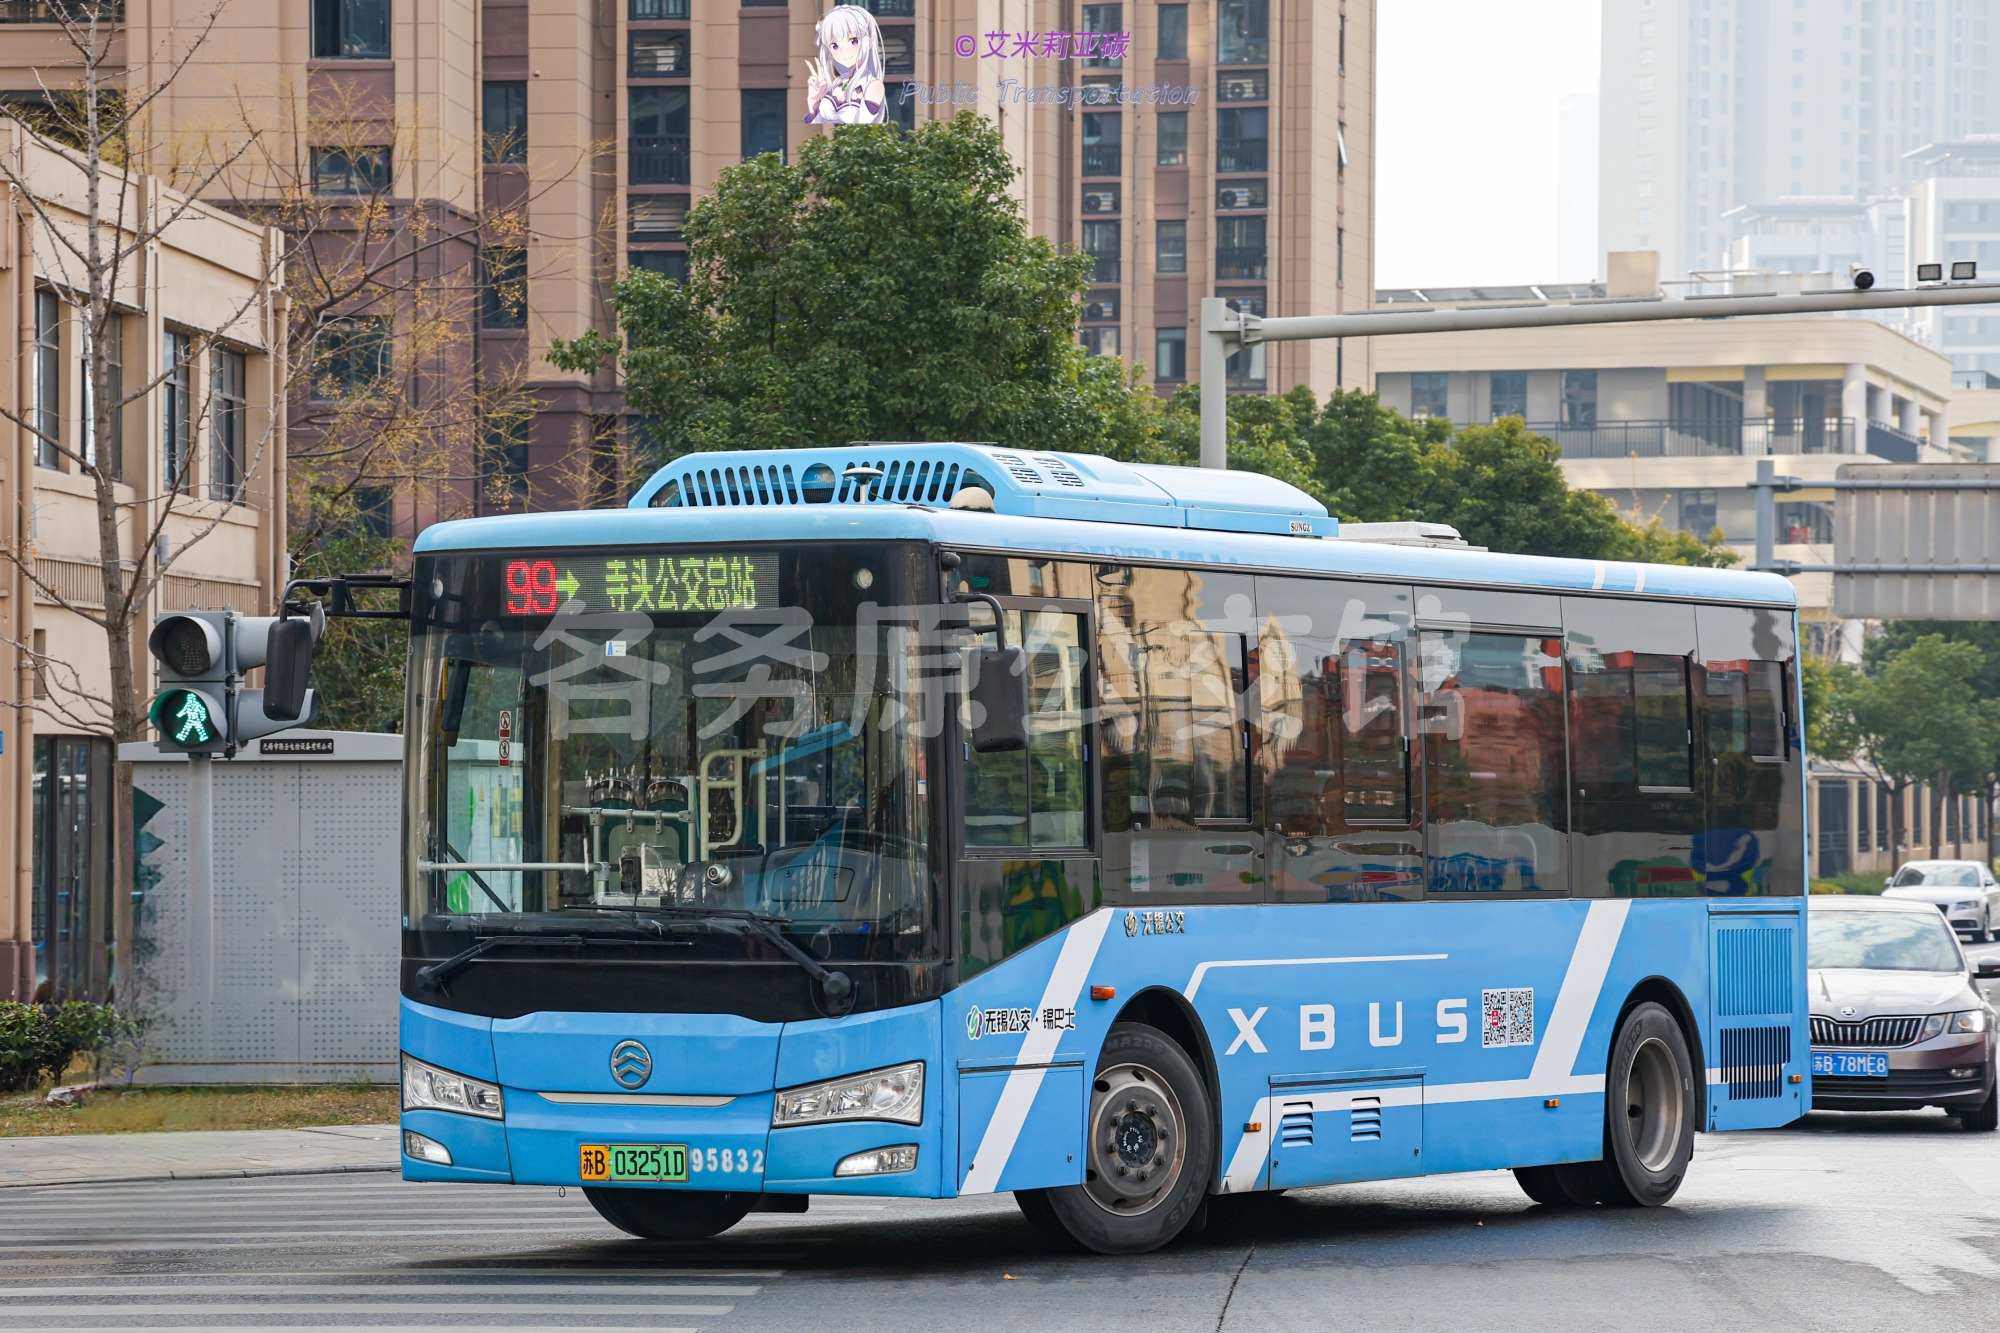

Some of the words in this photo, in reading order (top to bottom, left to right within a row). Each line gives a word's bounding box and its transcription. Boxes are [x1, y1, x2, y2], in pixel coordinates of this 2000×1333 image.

[1290, 523, 1310, 532] SONGZ
[506, 561, 558, 614] 99
[605, 557, 755, 611] 寺头公交总站
[1141, 911, 1185, 935] 无锡公交
[691, 1148, 764, 1173] 95832
